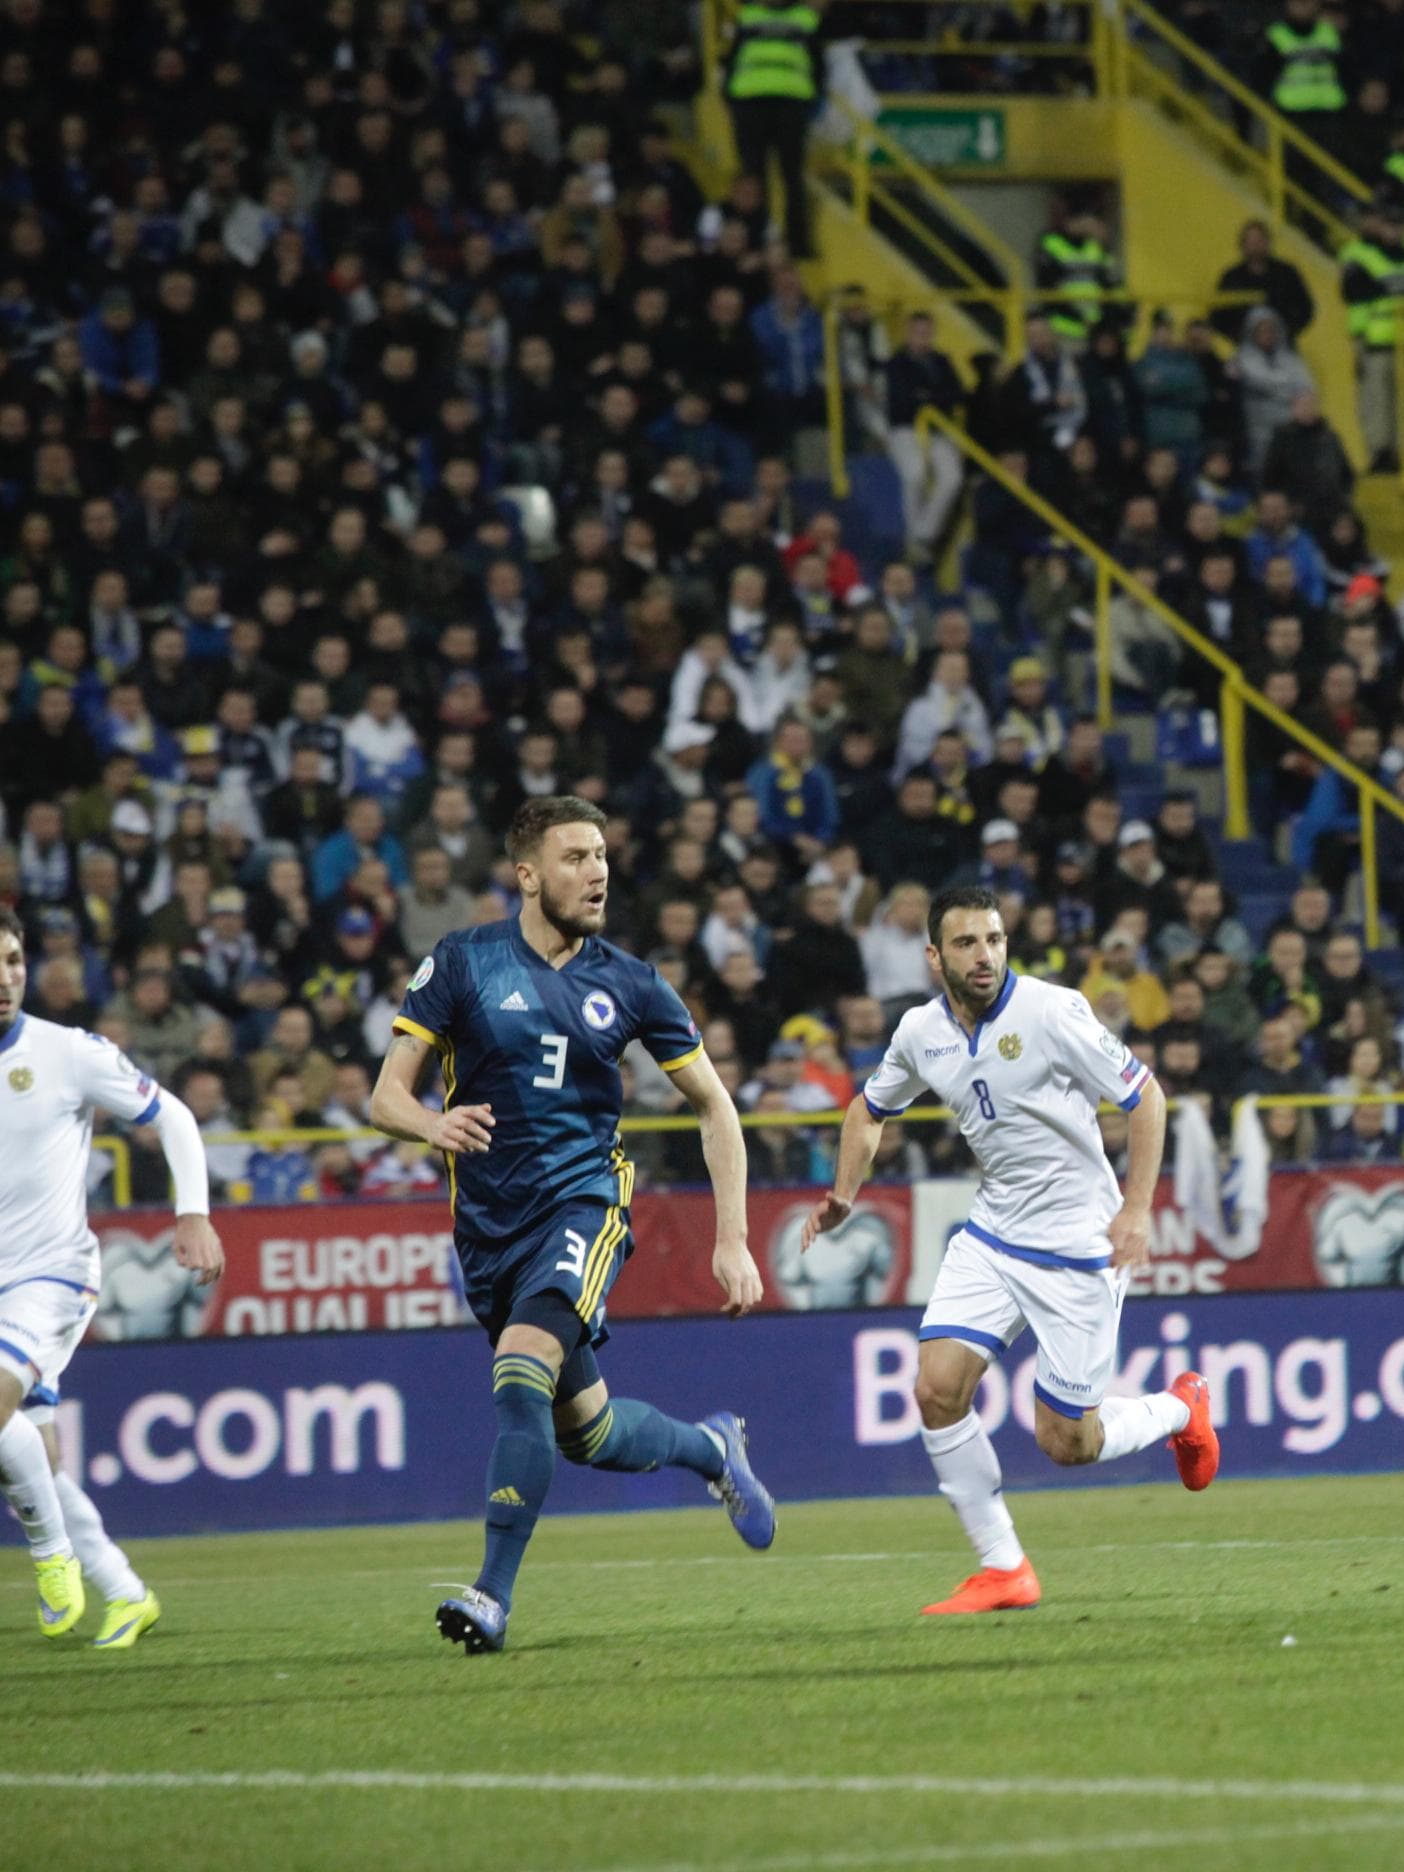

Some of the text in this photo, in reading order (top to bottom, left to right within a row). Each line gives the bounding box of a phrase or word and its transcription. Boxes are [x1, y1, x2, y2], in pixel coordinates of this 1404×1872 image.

[533, 1033, 569, 1090] 3
[924, 1043, 961, 1059] macron
[972, 1078, 996, 1120] 8
[555, 1228, 587, 1278] 3
